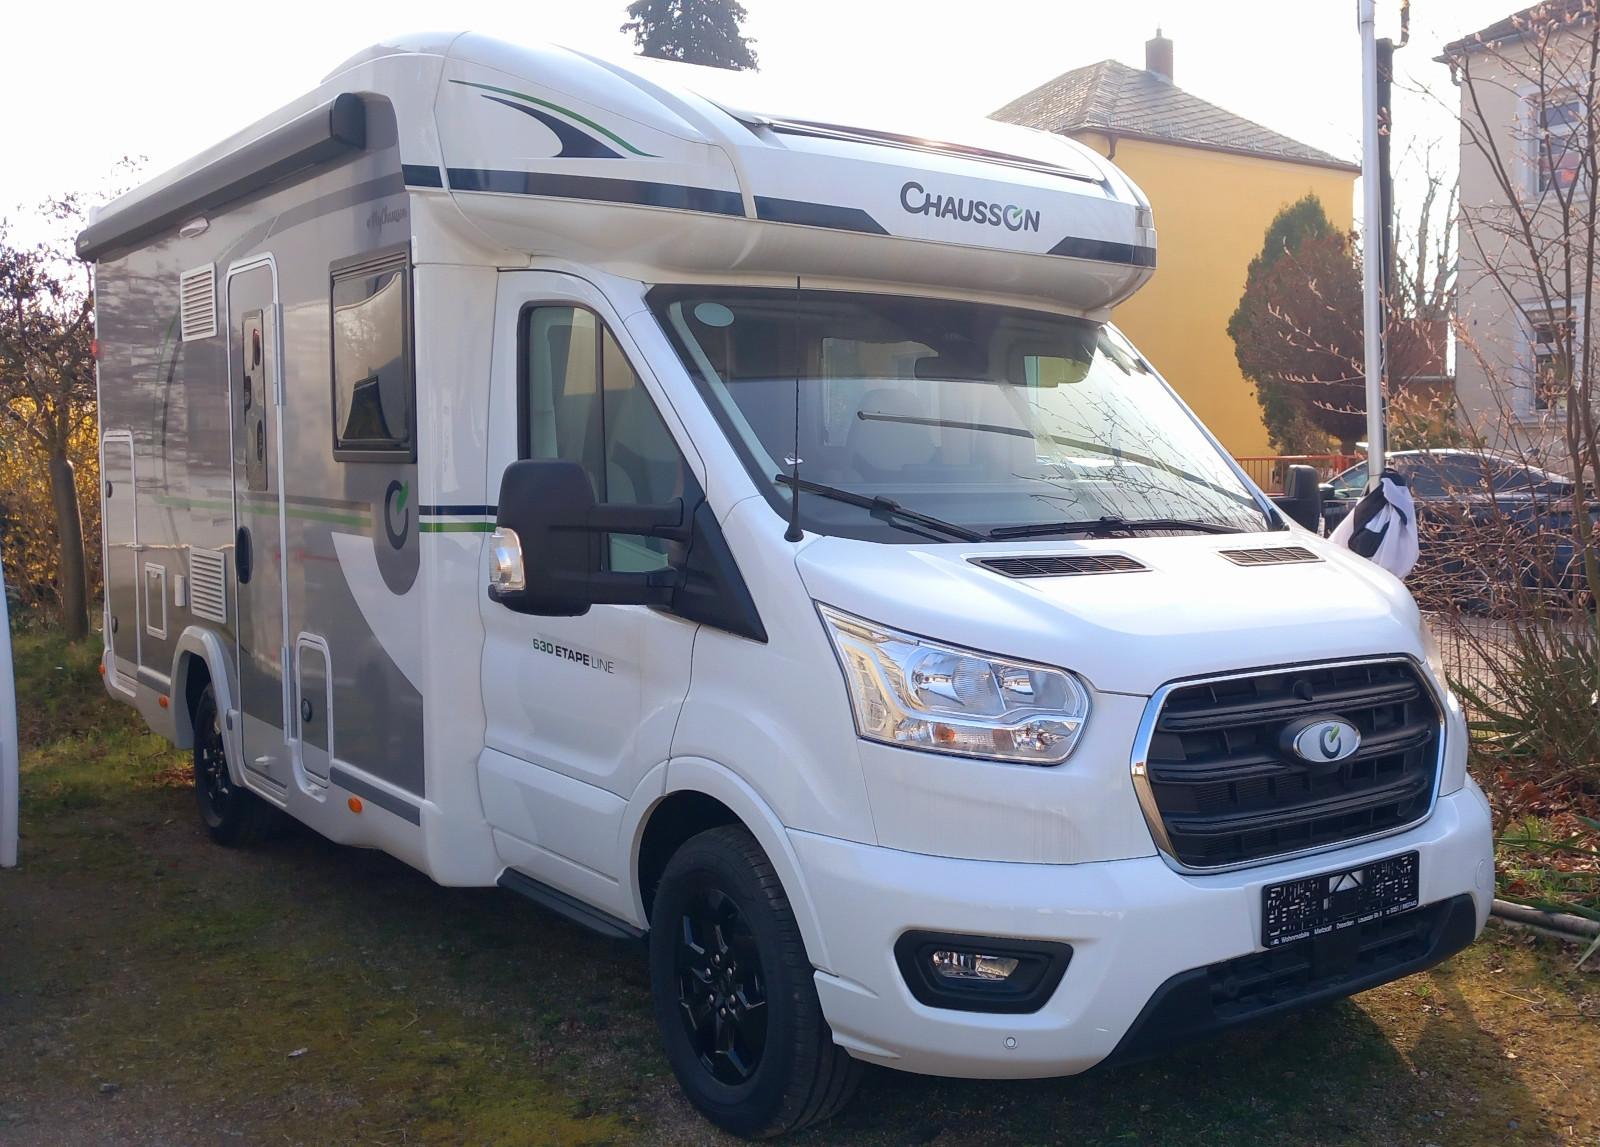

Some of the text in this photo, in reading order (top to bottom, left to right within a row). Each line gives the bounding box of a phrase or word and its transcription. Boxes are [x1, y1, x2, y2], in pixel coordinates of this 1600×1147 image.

[900, 181, 1041, 233] CHAUSSON
[532, 638, 615, 675] 630 ETAPE LINE
[1281, 931, 1310, 944] Wohnmobile
